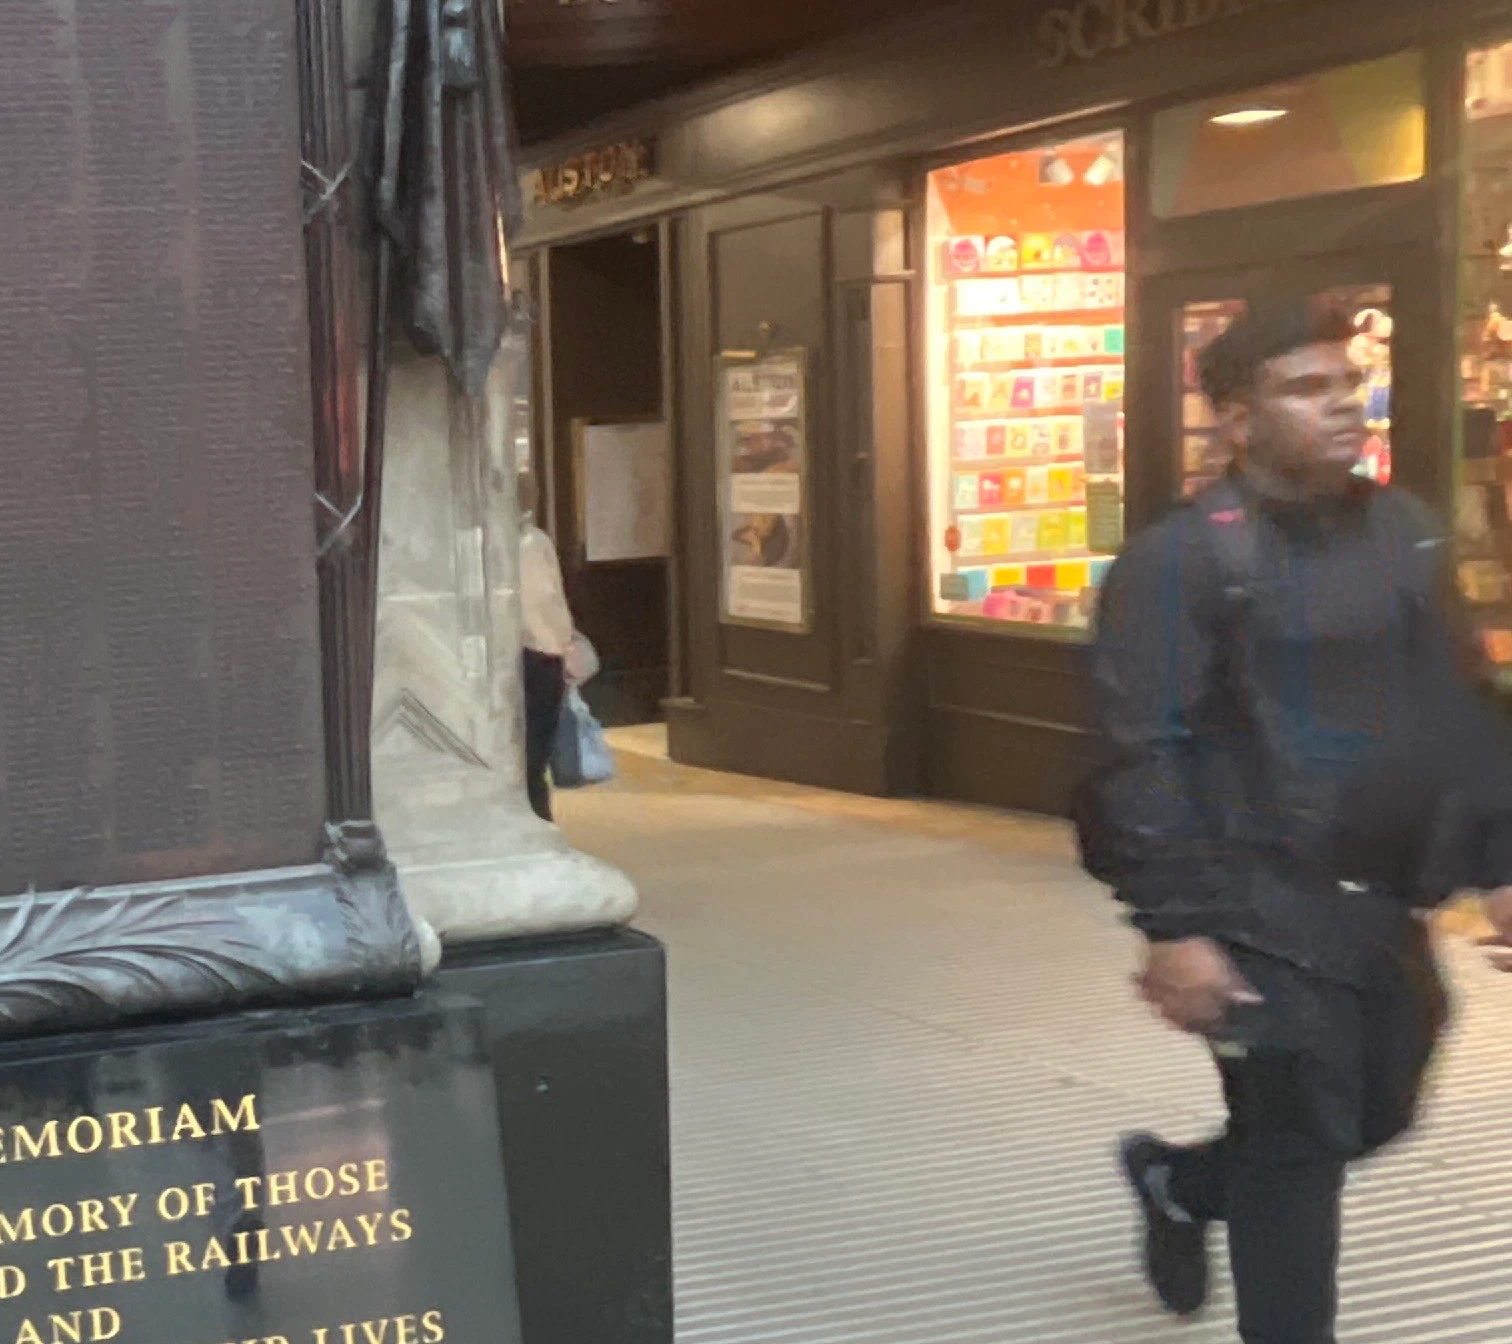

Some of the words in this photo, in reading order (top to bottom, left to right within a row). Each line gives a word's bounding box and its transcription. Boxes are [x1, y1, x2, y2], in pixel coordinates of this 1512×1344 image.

[157, 1182, 215, 1221] OF
[235, 1159, 390, 1209] THOSE
[47, 1248, 146, 1292] THE
[163, 1208, 413, 1276] RAILWAYS
